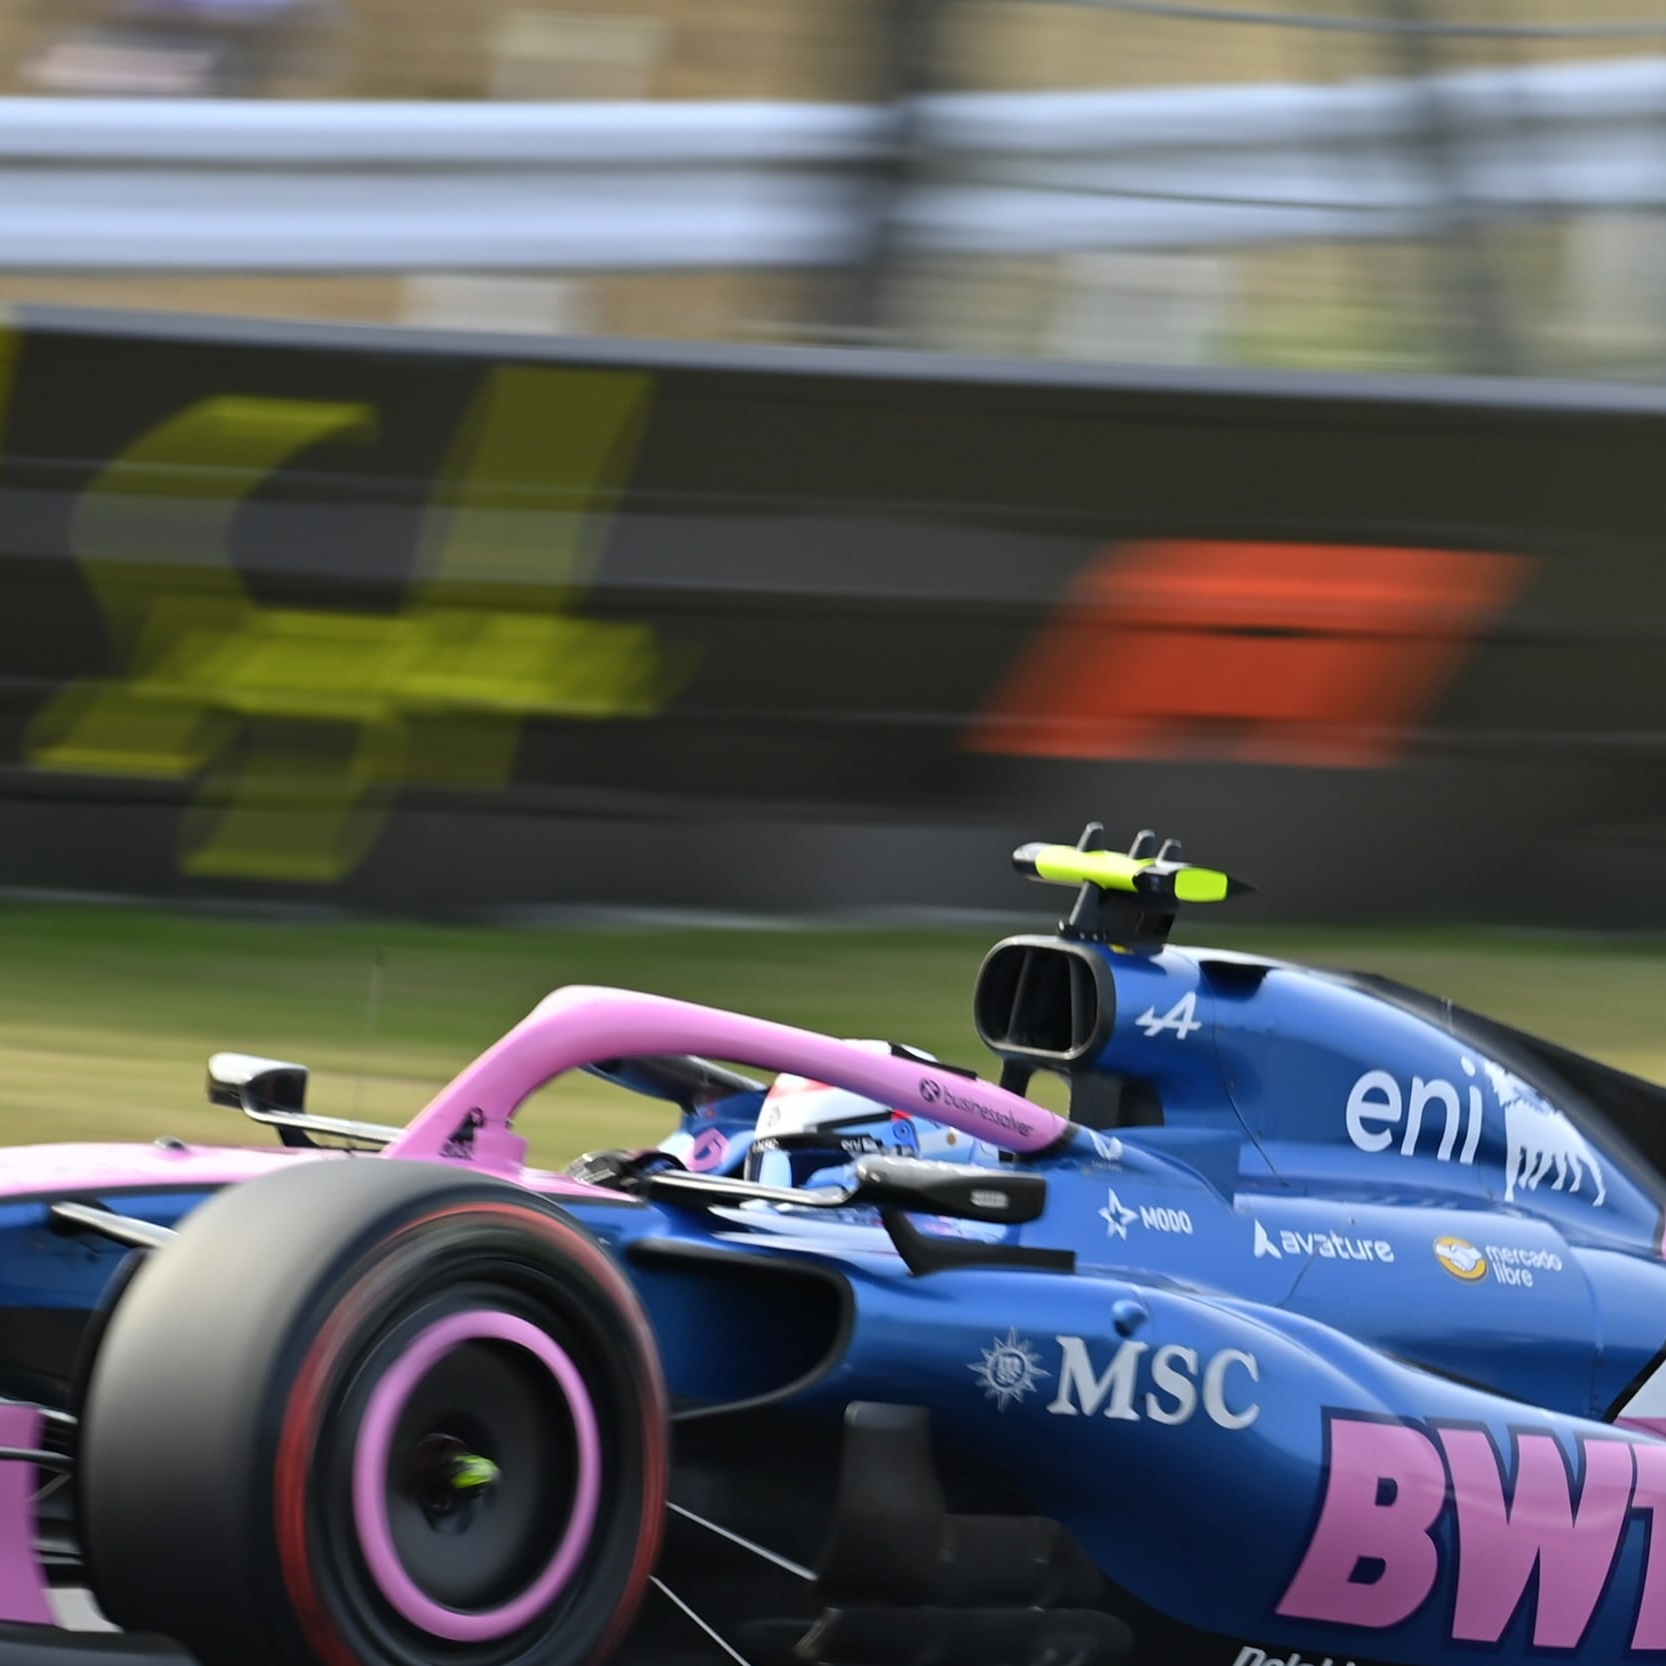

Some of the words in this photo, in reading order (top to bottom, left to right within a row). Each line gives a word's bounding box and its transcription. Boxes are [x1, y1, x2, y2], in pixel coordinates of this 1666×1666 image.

[943, 1085, 1035, 1137] businessolver
[1345, 1056, 1484, 1165] eni
[1141, 1208, 1194, 1235] MODO
[1280, 1229, 1395, 1263] avature
[1486, 1243, 1563, 1272] mercado
[1493, 1260, 1534, 1289] libre
[1045, 1335, 1261, 1430] MSC
